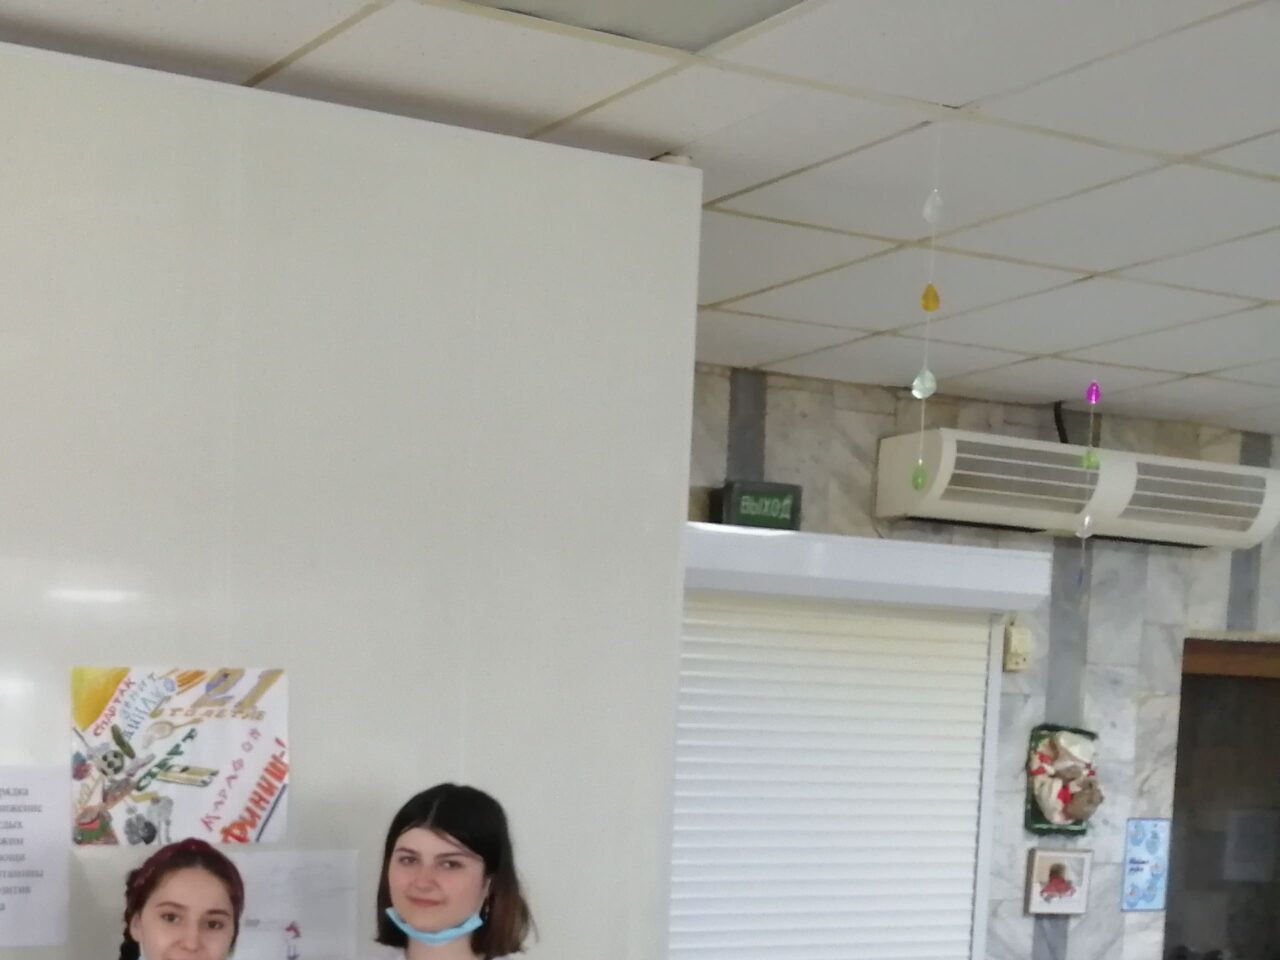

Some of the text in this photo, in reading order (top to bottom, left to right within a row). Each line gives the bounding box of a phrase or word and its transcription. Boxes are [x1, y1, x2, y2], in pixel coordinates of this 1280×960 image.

[740, 494, 794, 520] ВЫХОД
[93, 677, 136, 737] СПАРТАК
[201, 727, 262, 832] МАРАФОН
